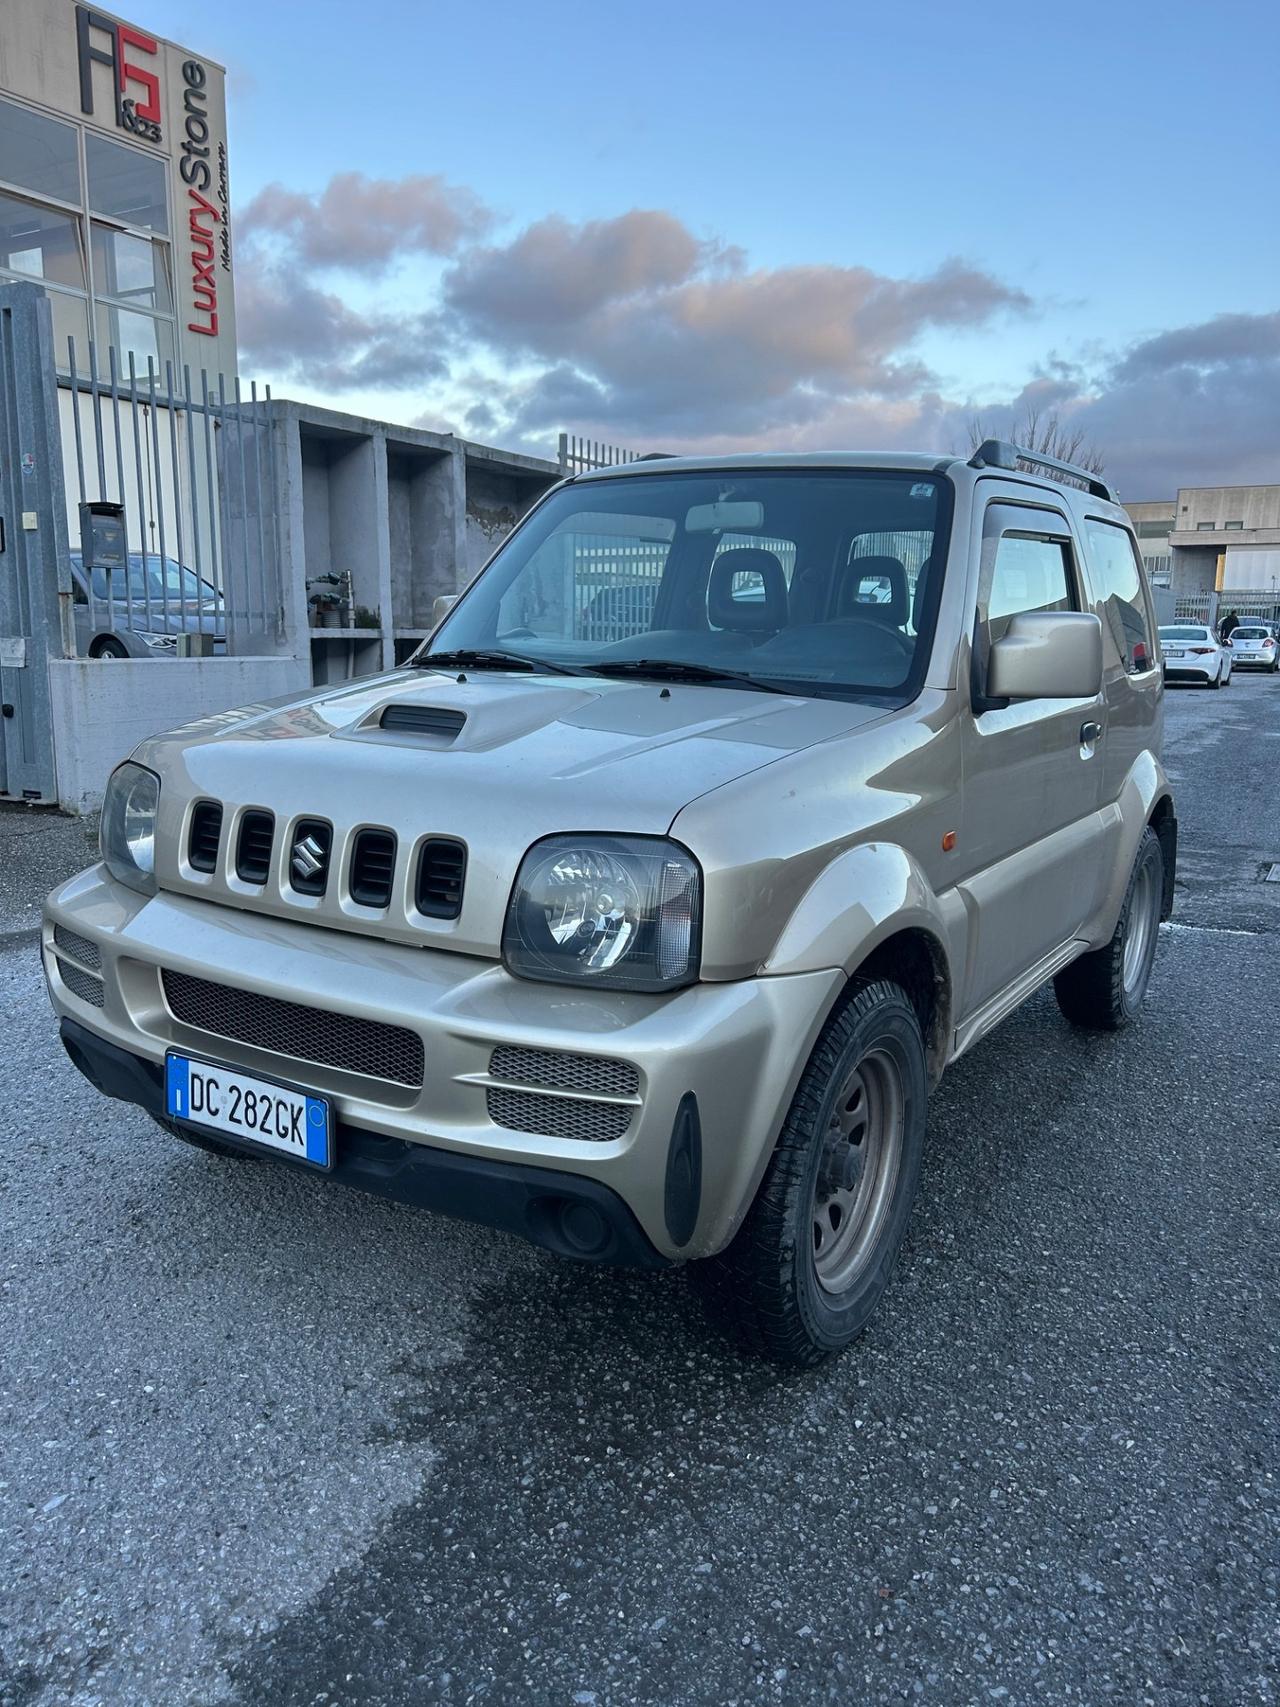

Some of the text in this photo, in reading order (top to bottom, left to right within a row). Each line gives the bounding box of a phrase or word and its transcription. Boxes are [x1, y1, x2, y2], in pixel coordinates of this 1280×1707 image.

[217, 140, 231, 272] Made in Carrara
[190, 1072, 304, 1146] DC 282GK
